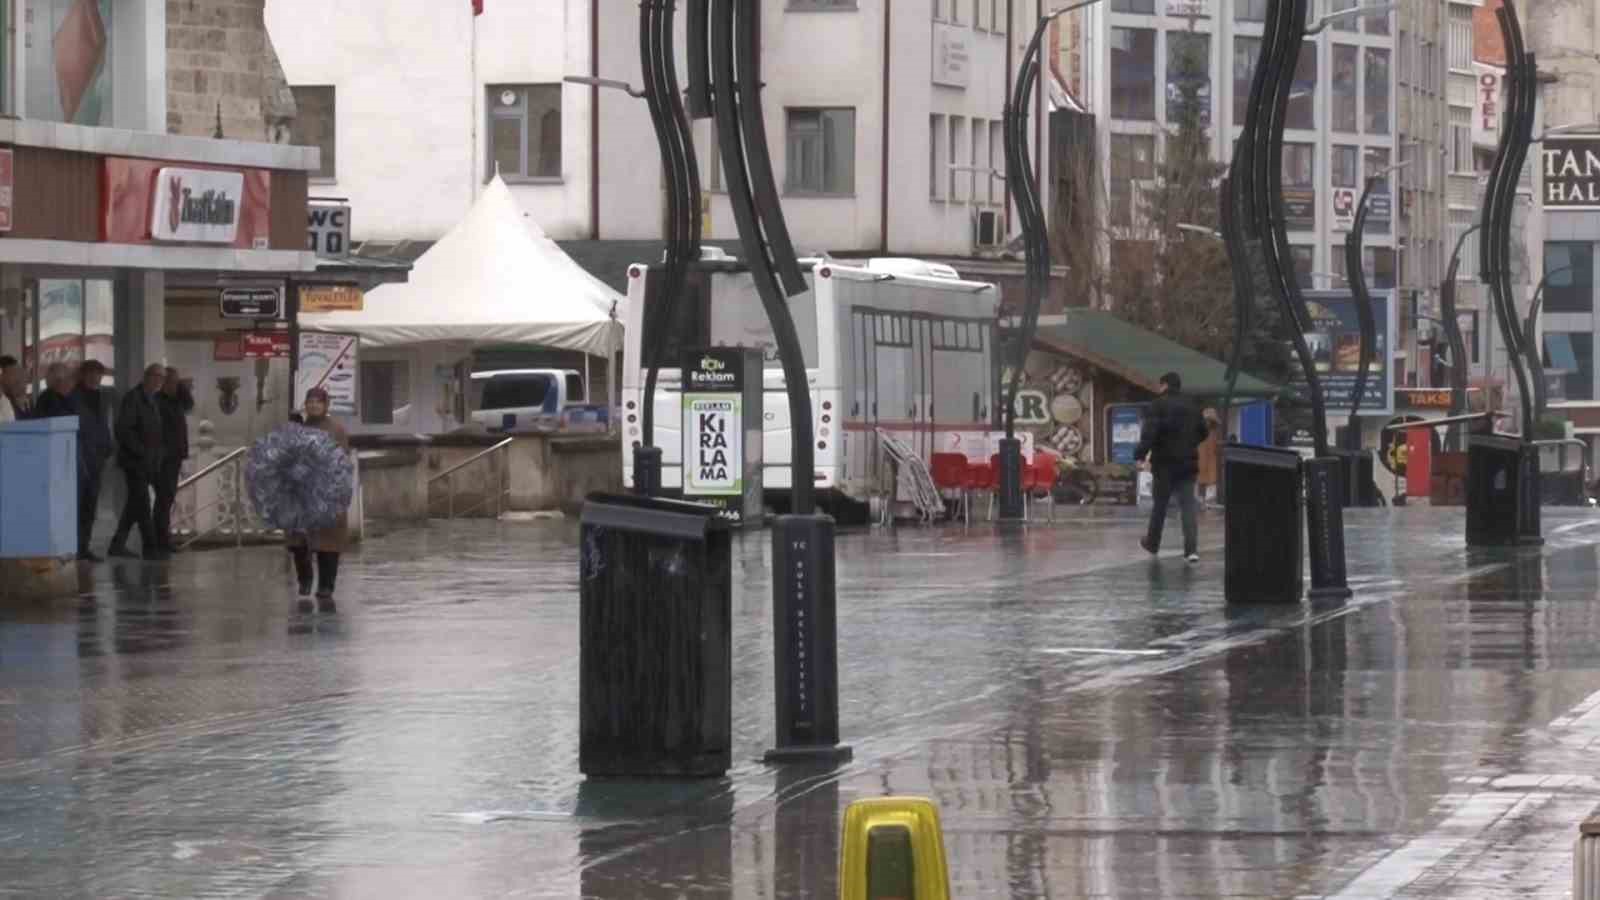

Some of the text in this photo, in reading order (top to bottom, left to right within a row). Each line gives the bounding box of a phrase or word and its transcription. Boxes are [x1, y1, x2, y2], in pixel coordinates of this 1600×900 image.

[1481, 73, 1496, 131] OTEL
[307, 210, 344, 228] WC
[691, 370, 735, 381] Reklam
[700, 433, 727, 448] RA
[700, 449, 727, 466] LA
[700, 467, 727, 480] MA
